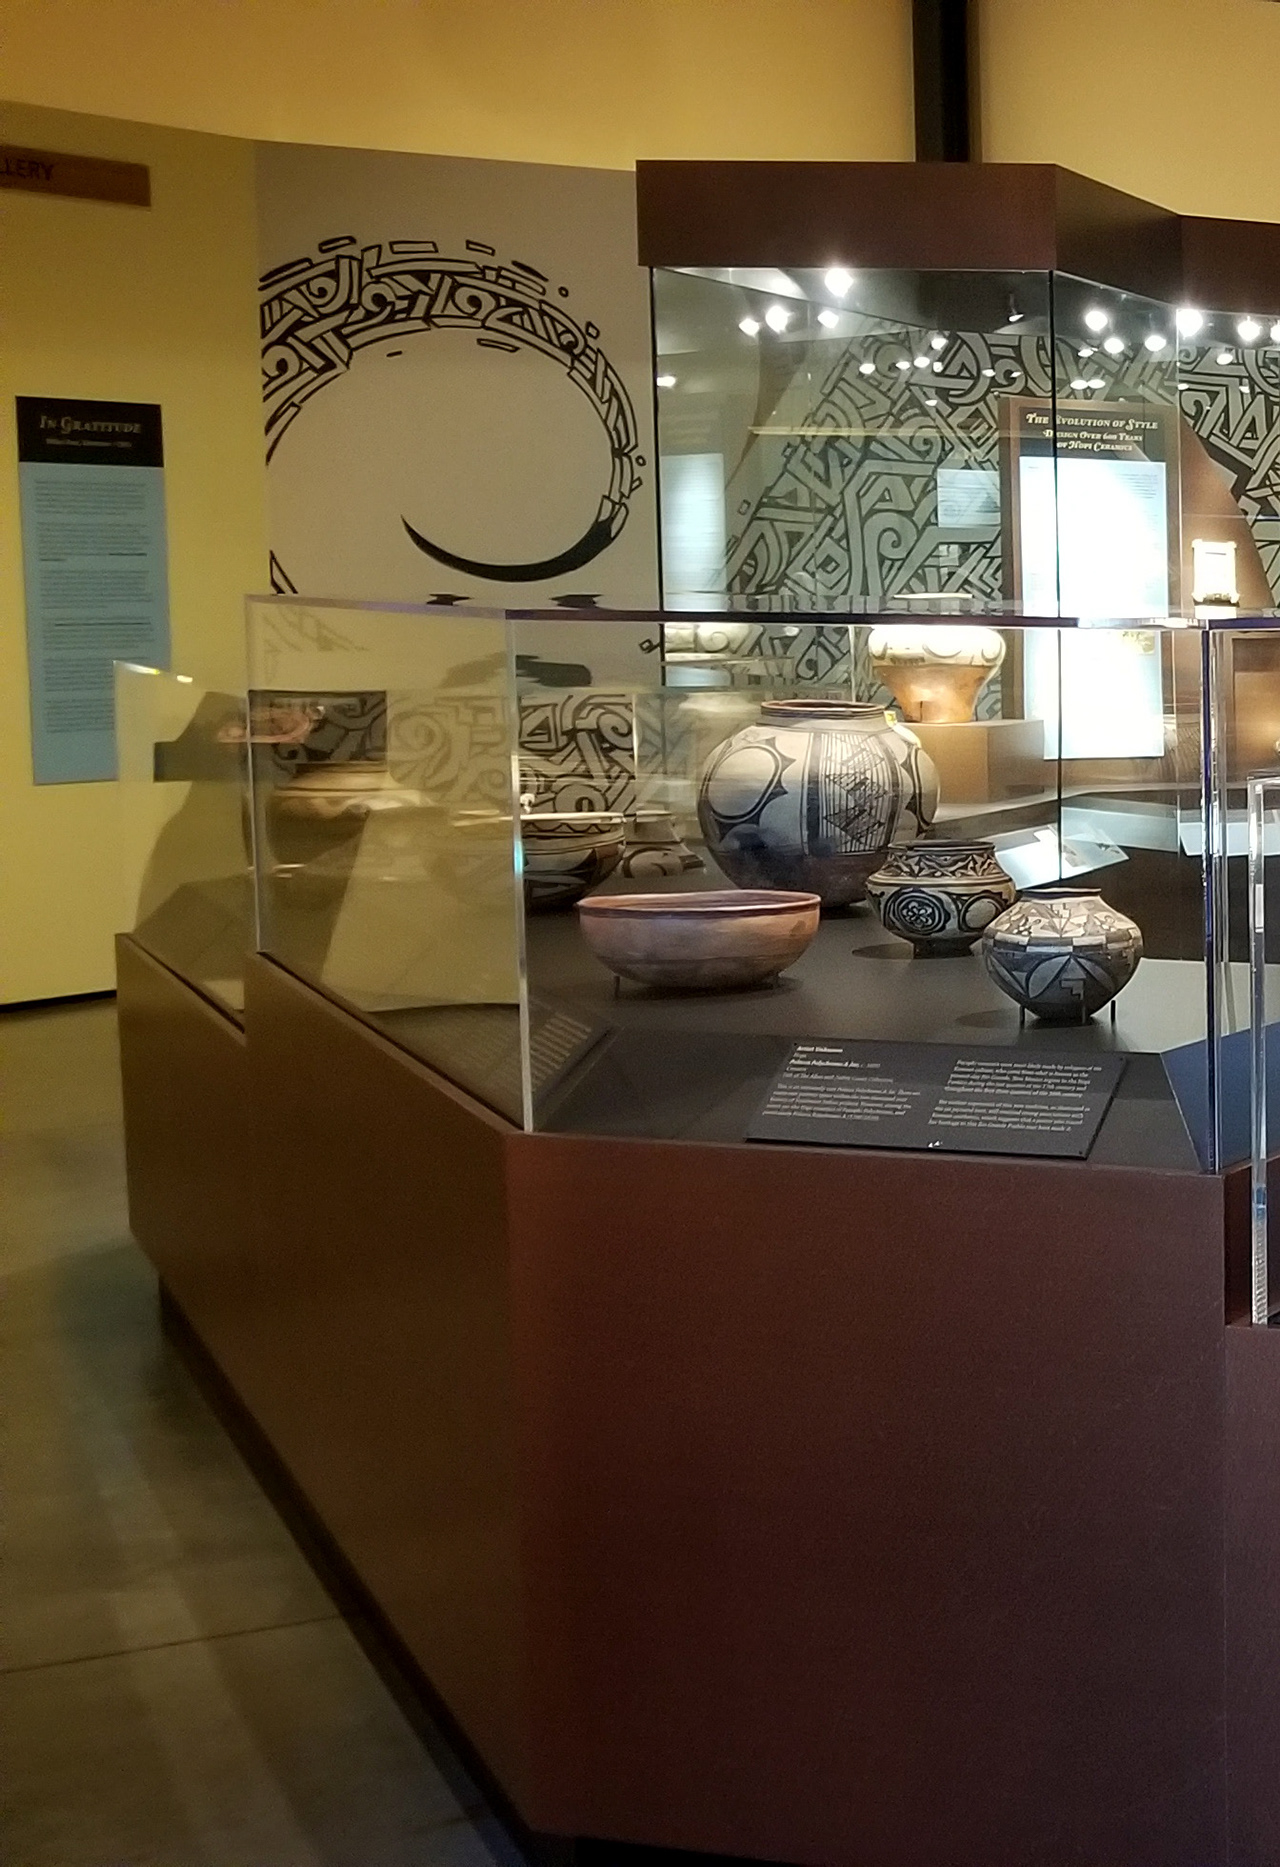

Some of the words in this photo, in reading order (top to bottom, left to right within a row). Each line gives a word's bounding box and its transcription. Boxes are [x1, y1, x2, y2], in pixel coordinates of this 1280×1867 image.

[40, 415, 57, 429] IN
[61, 416, 141, 434] GRATITUDE
[1026, 412, 1049, 425] THE
[1112, 419, 1125, 427] OF
[1125, 418, 1158, 431] STYLE
[1079, 431, 1101, 440] OVER
[1119, 432, 1143, 441] YEARS
[1068, 440, 1093, 450] HOPI
[1093, 441, 1132, 452] CERAMICS
